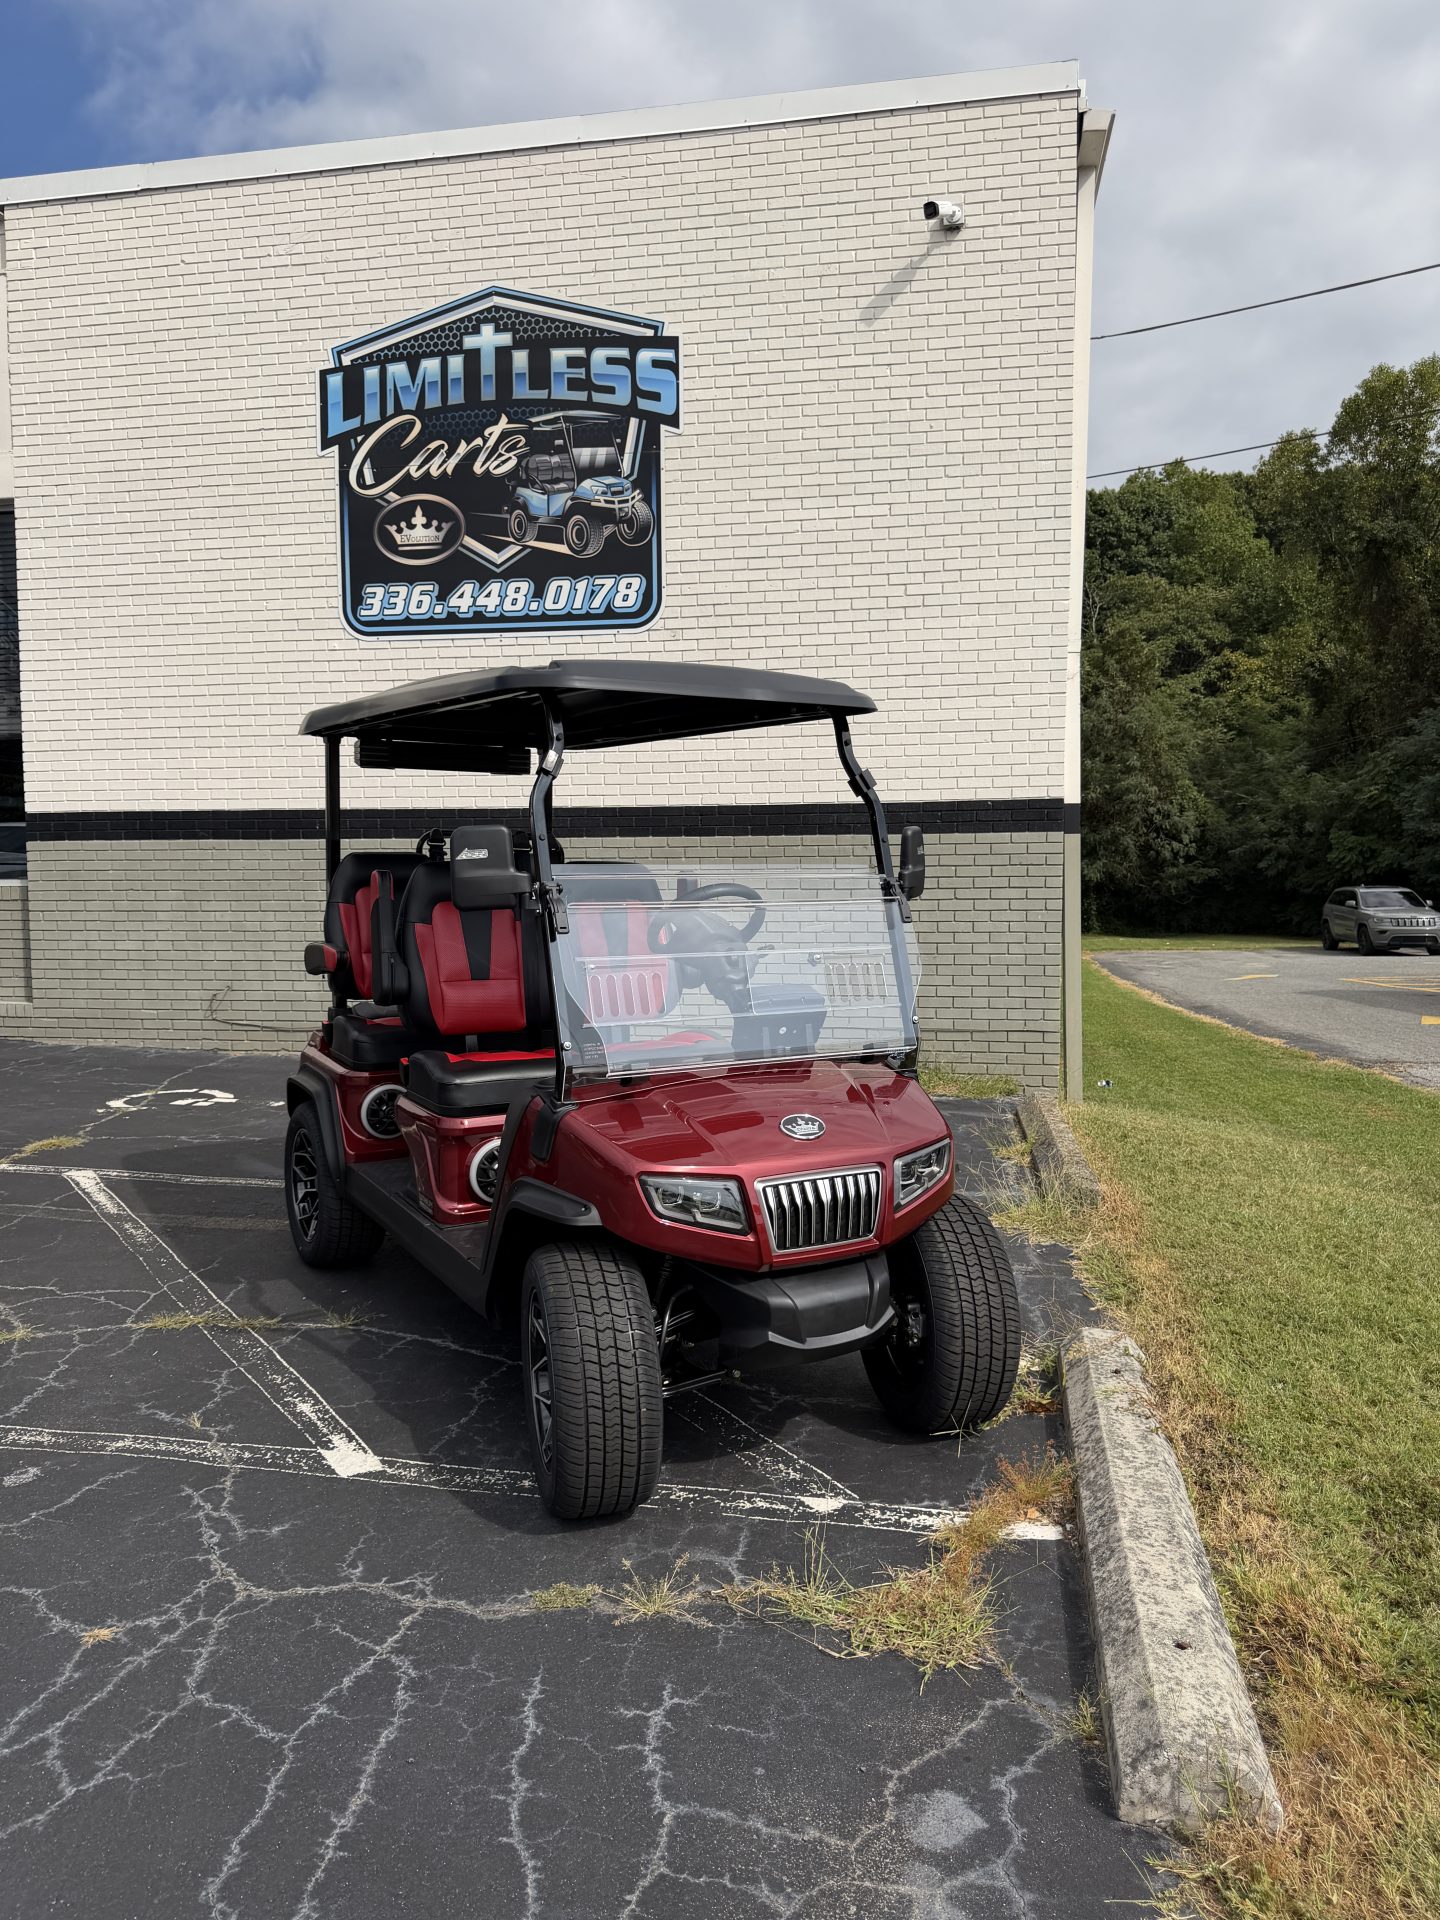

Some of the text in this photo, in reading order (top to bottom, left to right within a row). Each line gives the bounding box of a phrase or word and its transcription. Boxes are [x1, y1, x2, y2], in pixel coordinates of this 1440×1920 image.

[326, 323, 678, 438] LIMITLESS
[349, 414, 530, 497] Carts
[359, 576, 645, 618] 336.448.0178
